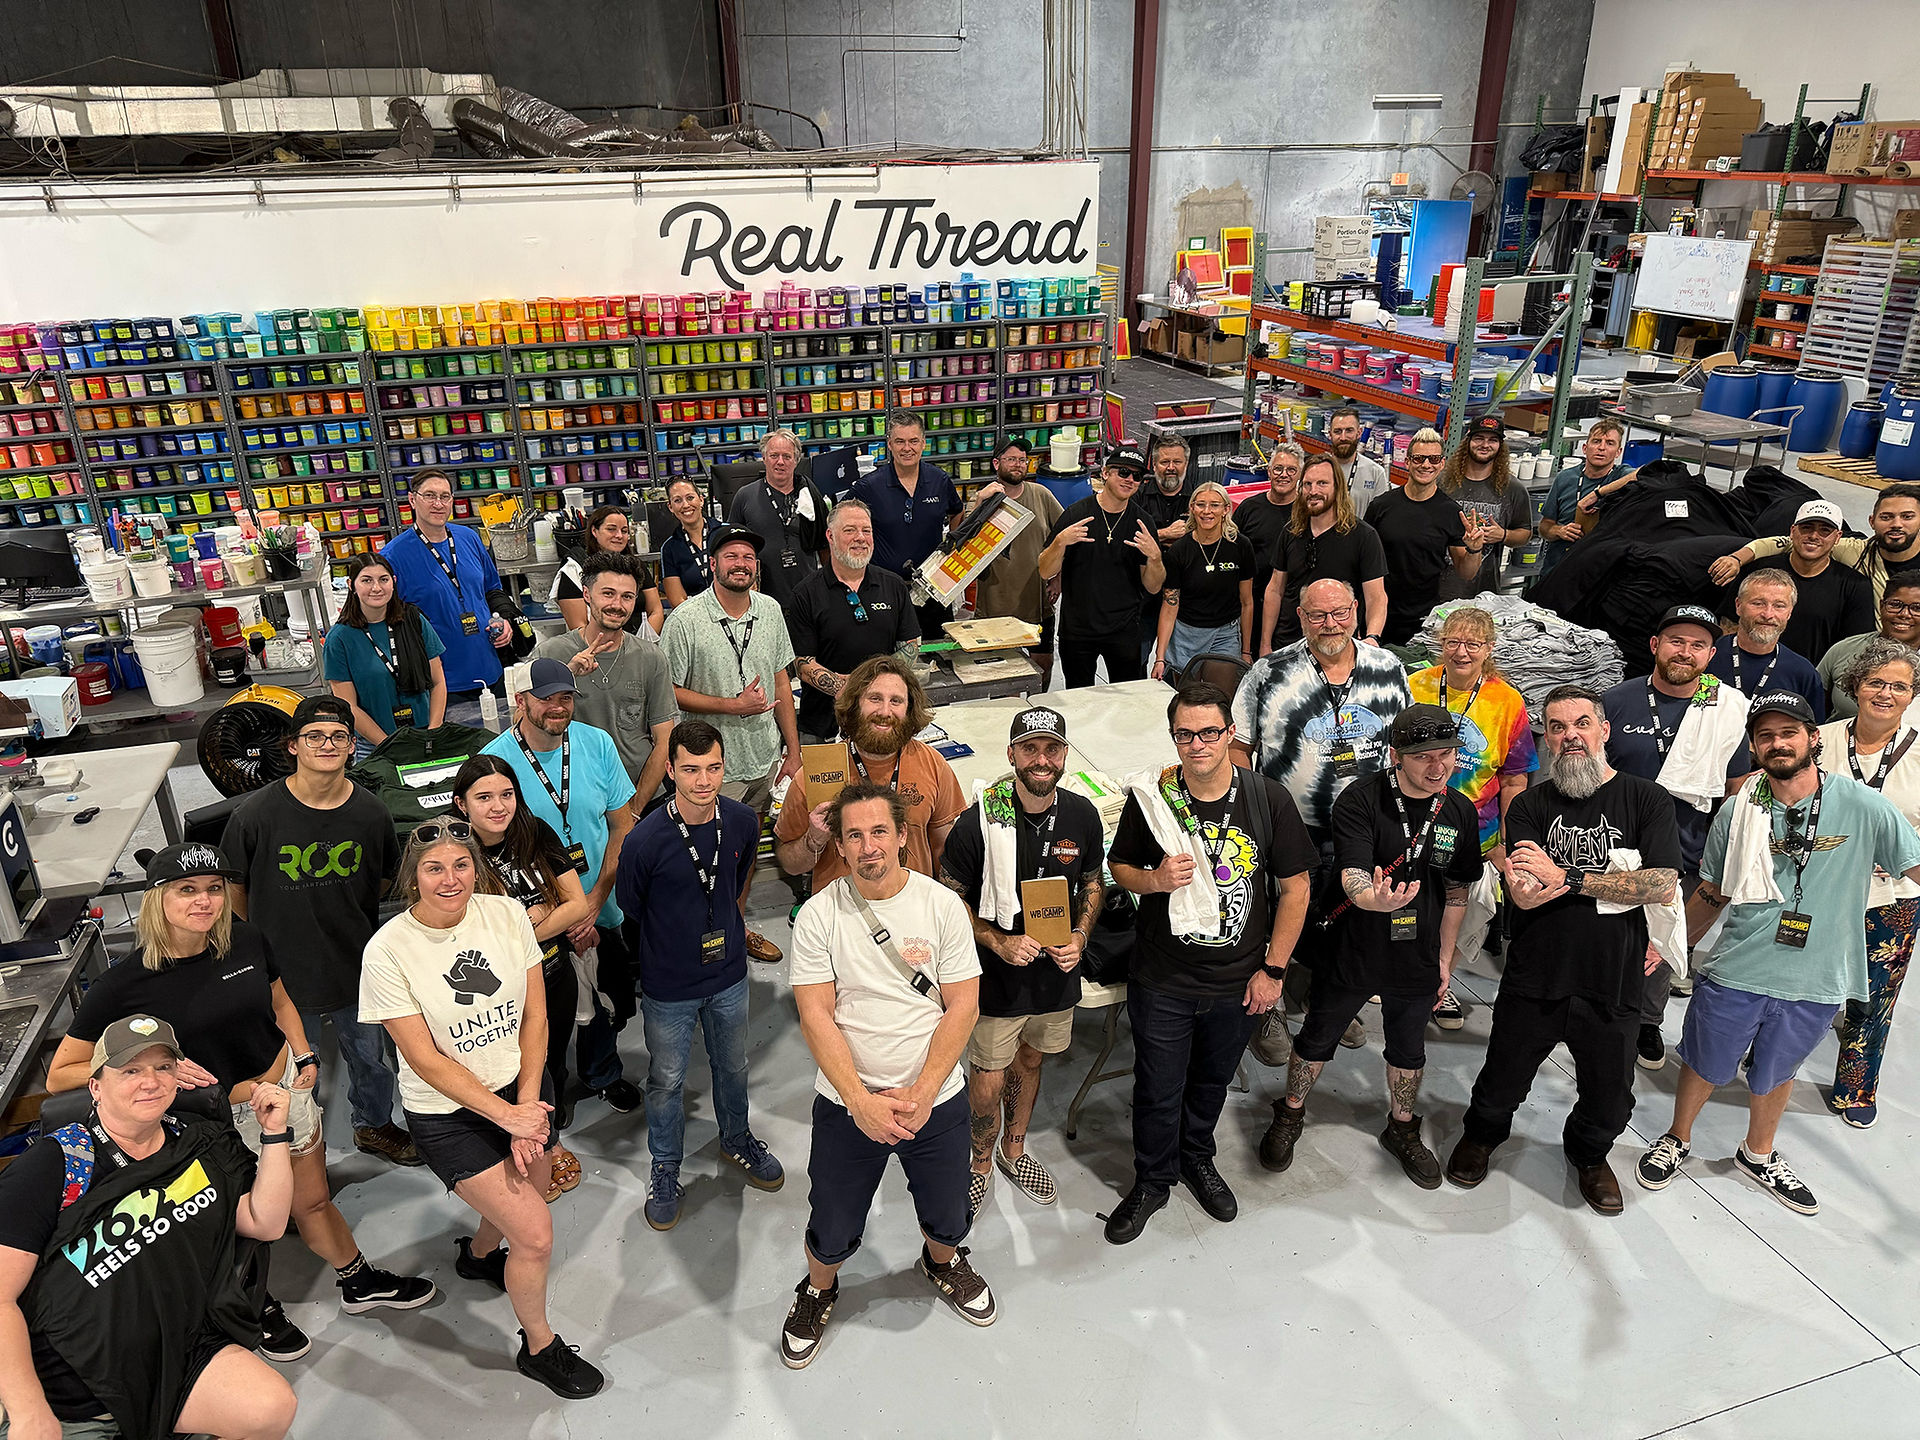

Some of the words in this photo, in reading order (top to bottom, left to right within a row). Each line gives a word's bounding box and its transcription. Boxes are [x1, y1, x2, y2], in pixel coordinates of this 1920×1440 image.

[660, 198, 843, 290] Real
[854, 198, 1090, 269] Thread
[247, 748, 261, 756] CAT
[809, 774, 820, 783] WB
[822, 772, 844, 783] CAMP
[1434, 824, 1458, 837] LINKIN
[1436, 834, 1454, 844] PARK
[1030, 910, 1042, 919] WB
[1043, 907, 1064, 918] CAMP
[84, 1238, 142, 1288] FEELS
[142, 1217, 170, 1244] SO
[172, 1188, 218, 1222] GOOD
